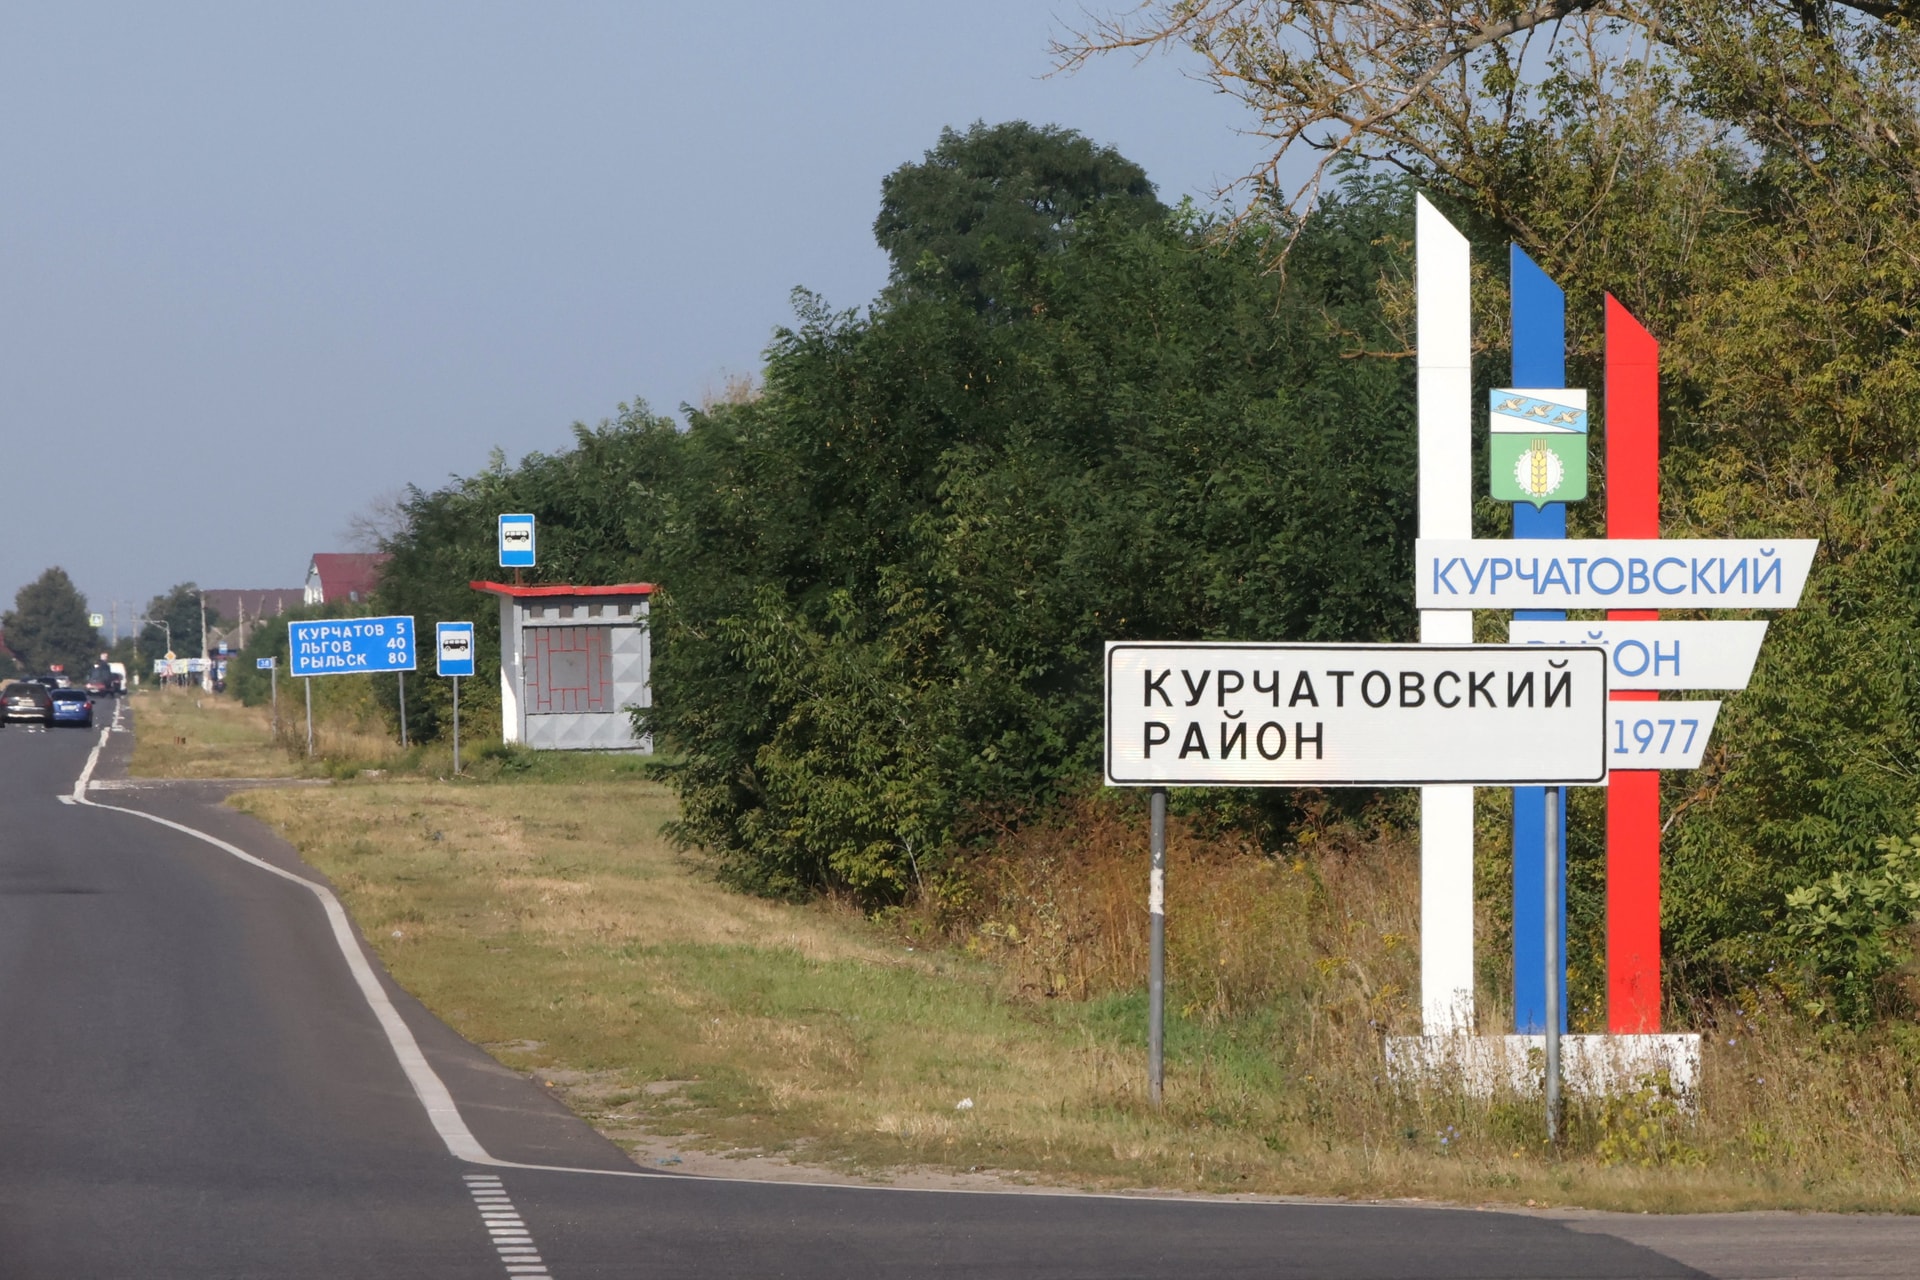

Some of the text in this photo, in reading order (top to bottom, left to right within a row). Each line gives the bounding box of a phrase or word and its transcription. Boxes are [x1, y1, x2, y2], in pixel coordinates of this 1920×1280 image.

[1433, 548, 1781, 595] КУРЧАТОВСКИЙ
[298, 622, 405, 641] КУРЧАТОВ 5
[301, 637, 406, 655] ЛЬГОВ 40
[301, 652, 407, 669] РЫЛЬСК 80
[1144, 659, 1571, 708] КУРЧАТОВСКИЙ
[1144, 710, 1323, 761] РАЙОН
[1614, 719, 1699, 754] 1977
